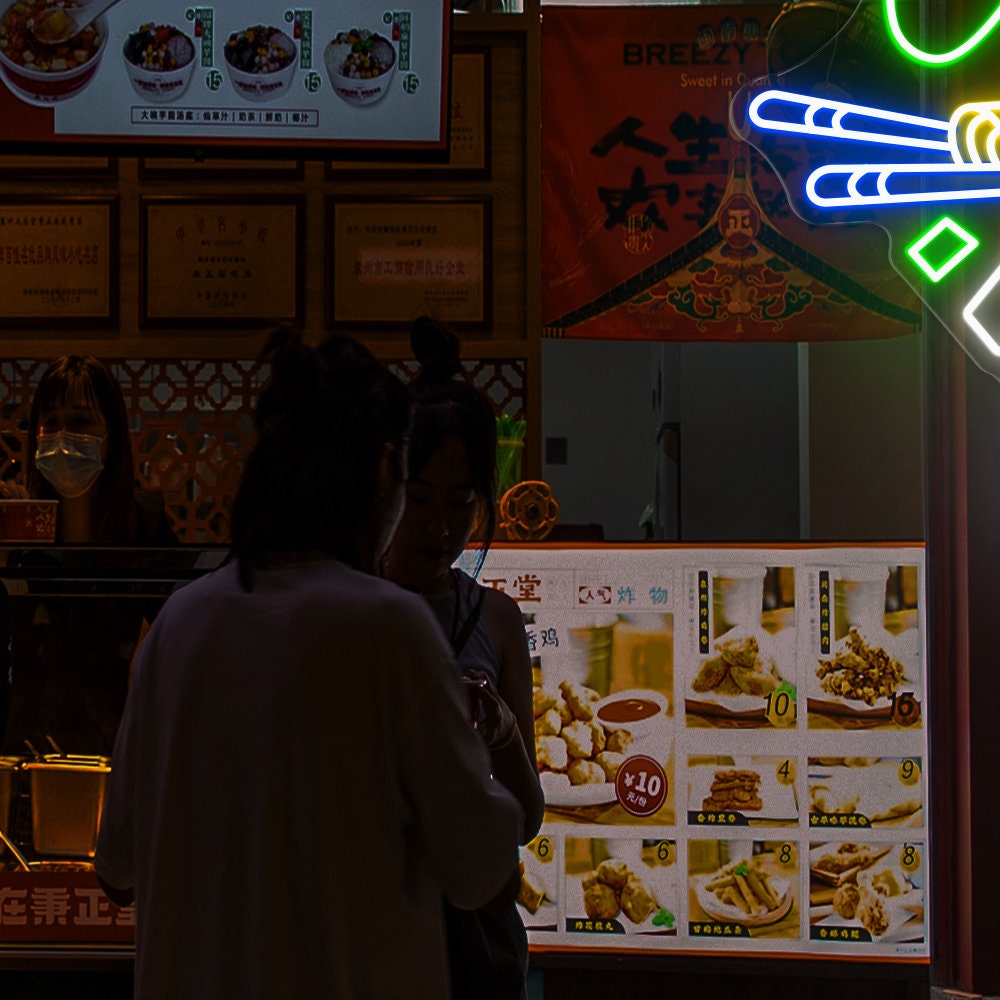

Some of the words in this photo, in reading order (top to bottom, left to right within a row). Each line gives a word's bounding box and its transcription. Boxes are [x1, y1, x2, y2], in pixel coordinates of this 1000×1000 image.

[623, 42, 750, 66] BREEZY
[681, 73, 717, 88] Sweet
[721, 74, 733, 86] in
[585, 589, 607, 601] 人气
[617, 586, 669, 605] 炸物
[764, 692, 790, 717] 10
[778, 760, 790, 778] 4
[902, 760, 915, 779] 9
[624, 770, 662, 797] ¥10
[537, 838, 550, 858] 6
[657, 841, 669, 860] 6
[779, 844, 792, 863] 8
[903, 846, 915, 865] 8
[0, 886, 136, 925] 在秉正
